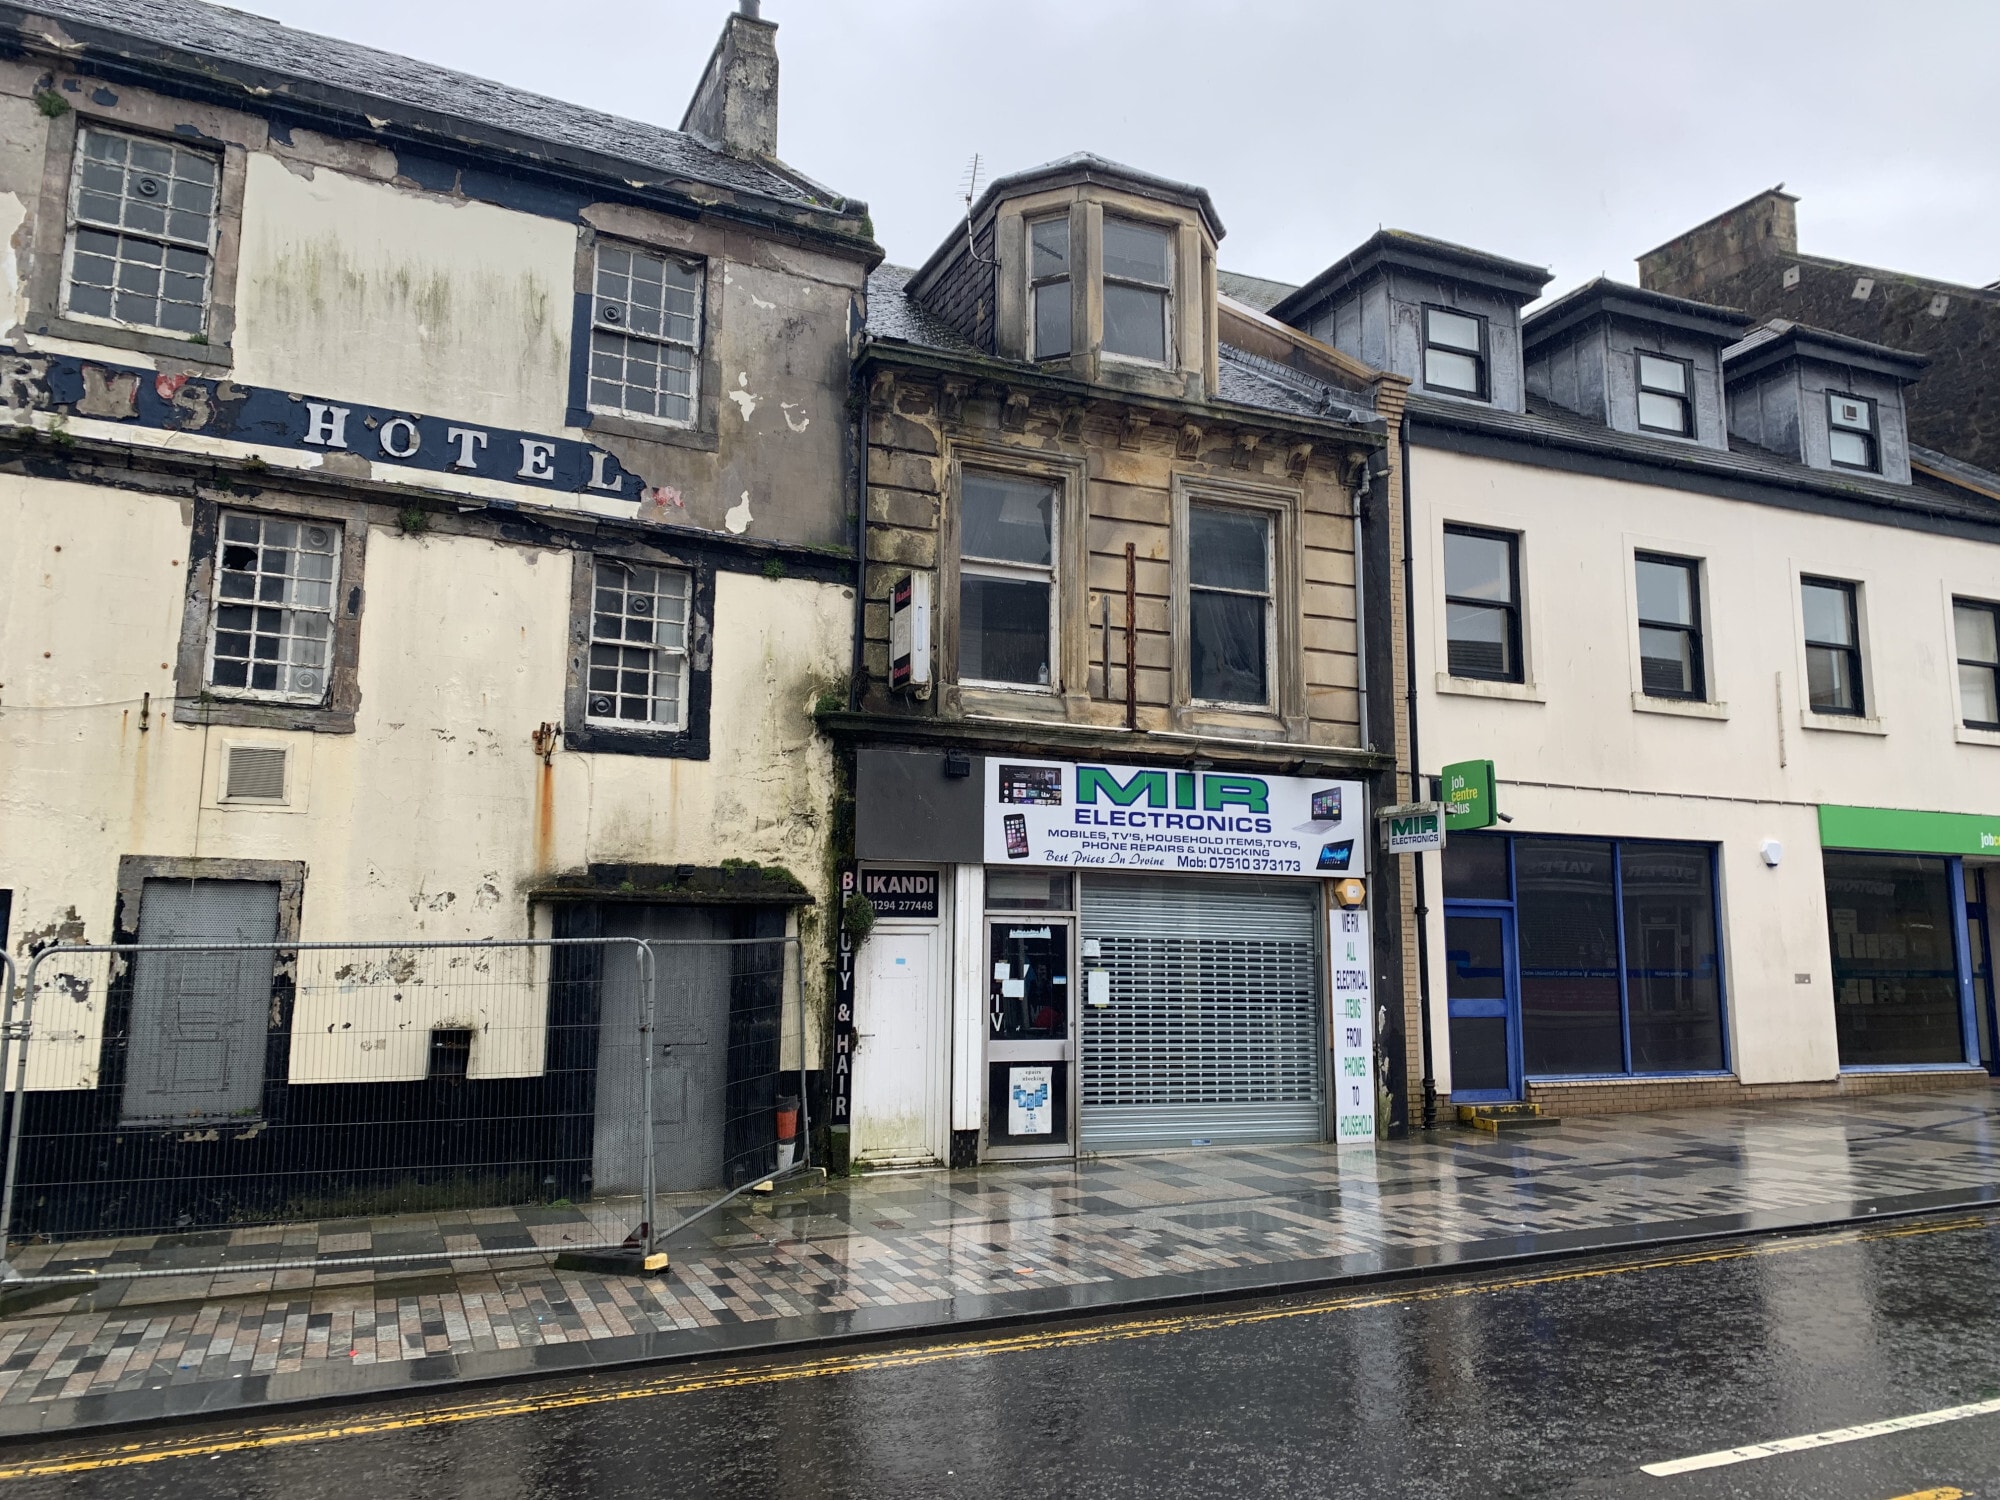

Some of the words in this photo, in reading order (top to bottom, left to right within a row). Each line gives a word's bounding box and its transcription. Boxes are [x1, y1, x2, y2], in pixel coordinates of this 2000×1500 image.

[304, 402, 623, 492] HOTEL
[1076, 766, 1270, 814] MIR
[1451, 775, 1465, 791] job
[1451, 787, 1478, 802] centre
[1075, 808, 1272, 833] ELECTRONICS
[1392, 815, 1438, 837] MIR
[1048, 829, 1110, 841] MOBILES,
[1112, 832, 1144, 843] TV'S,
[1146, 834, 1224, 845] HOUSEHOLD
[1391, 834, 1439, 846] ELECTRONICS
[1043, 849, 1069, 863] Best
[1071, 850, 1105, 866] Prices
[1108, 852, 1126, 865] In
[1129, 853, 1165, 866] Irvine
[1082, 841, 1128, 851] PHONE
[1130, 843, 1185, 854] REPAIRS
[1187, 846, 1196, 854] &
[1198, 847, 1270, 857] UNLOCKING
[1177, 855, 1207, 869] Mob:
[1209, 857, 1250, 870] 07510
[1252, 859, 1301, 872] 373173
[866, 876, 934, 894] IKANDI
[898, 901, 933, 910] 277448
[840, 871, 854, 991] BEUTY
[1342, 914, 1350, 932] WE
[1351, 914, 1359, 932] FIX
[1347, 942, 1356, 961] ALL
[1336, 970, 1368, 990] ELECTRICAL
[837, 1003, 850, 1022] &
[1345, 999, 1361, 1018] ITEMS
[1346, 1028, 1362, 1048] FROM
[835, 1034, 849, 1117] HAIR
[1344, 1057, 1366, 1077] PHONES
[1352, 1086, 1360, 1106] TO
[1340, 1115, 1373, 1136] HOUSEHOLD
